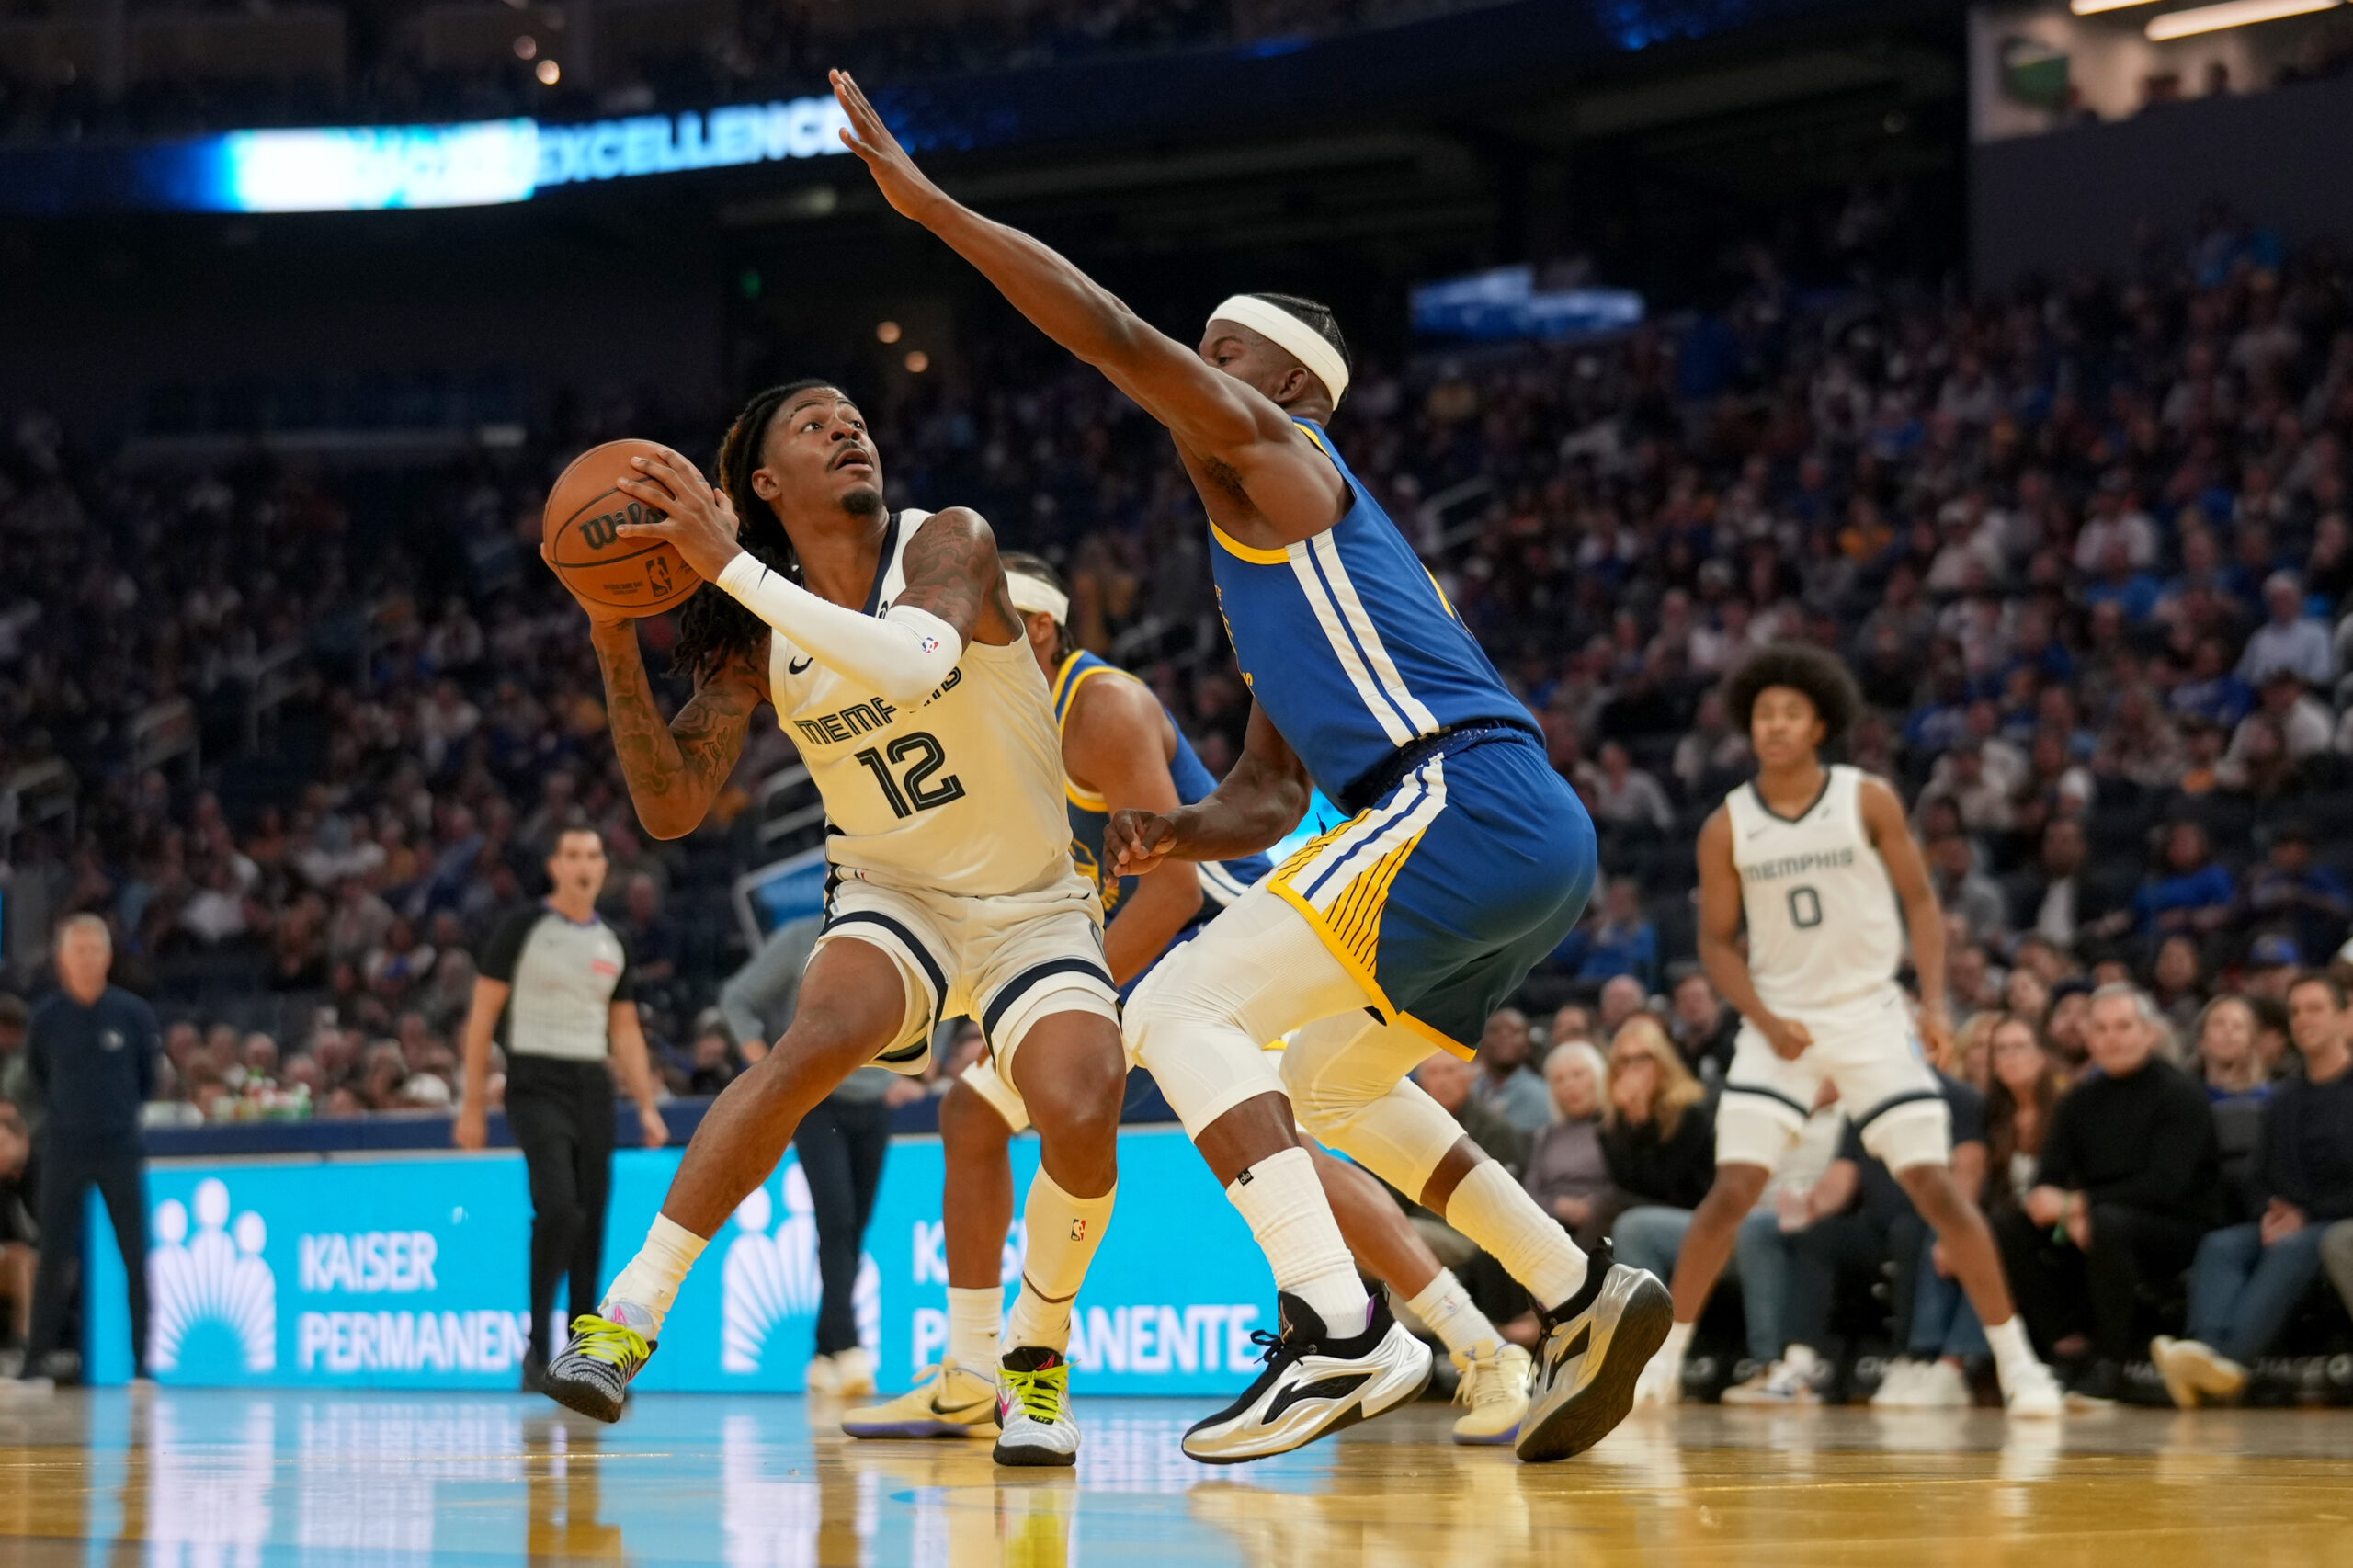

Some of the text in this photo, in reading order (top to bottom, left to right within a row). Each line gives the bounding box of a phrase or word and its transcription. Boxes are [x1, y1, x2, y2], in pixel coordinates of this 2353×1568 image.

[855, 732, 965, 819] 12
[1744, 846, 1854, 881] MEMPHIS
[1788, 885, 1824, 929] 0
[298, 1231, 438, 1291] KAISER
[298, 1311, 569, 1372] PERMANEN
[913, 1305, 1260, 1373] PANENTE
